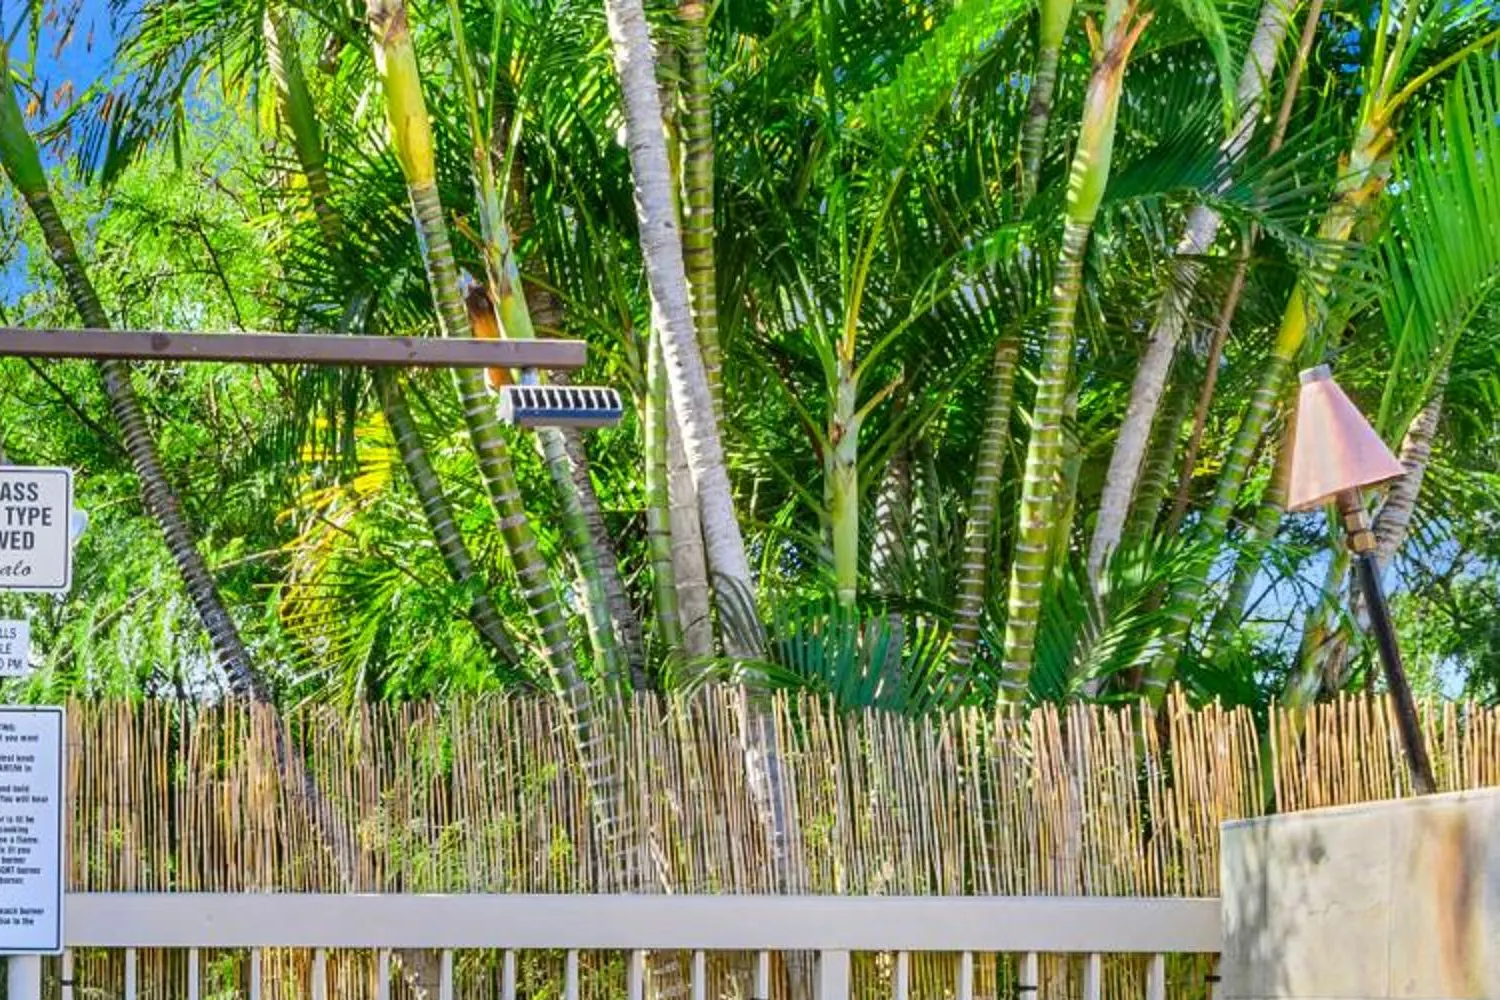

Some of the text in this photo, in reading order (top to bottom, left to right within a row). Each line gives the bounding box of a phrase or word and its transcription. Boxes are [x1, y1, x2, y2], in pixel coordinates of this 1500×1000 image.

[5, 507, 52, 526] TYPE
[7, 658, 23, 669] PM
[5, 733, 18, 742] you
[17, 846, 31, 854] you
[12, 917, 20, 925] to
[22, 917, 34, 925] the
